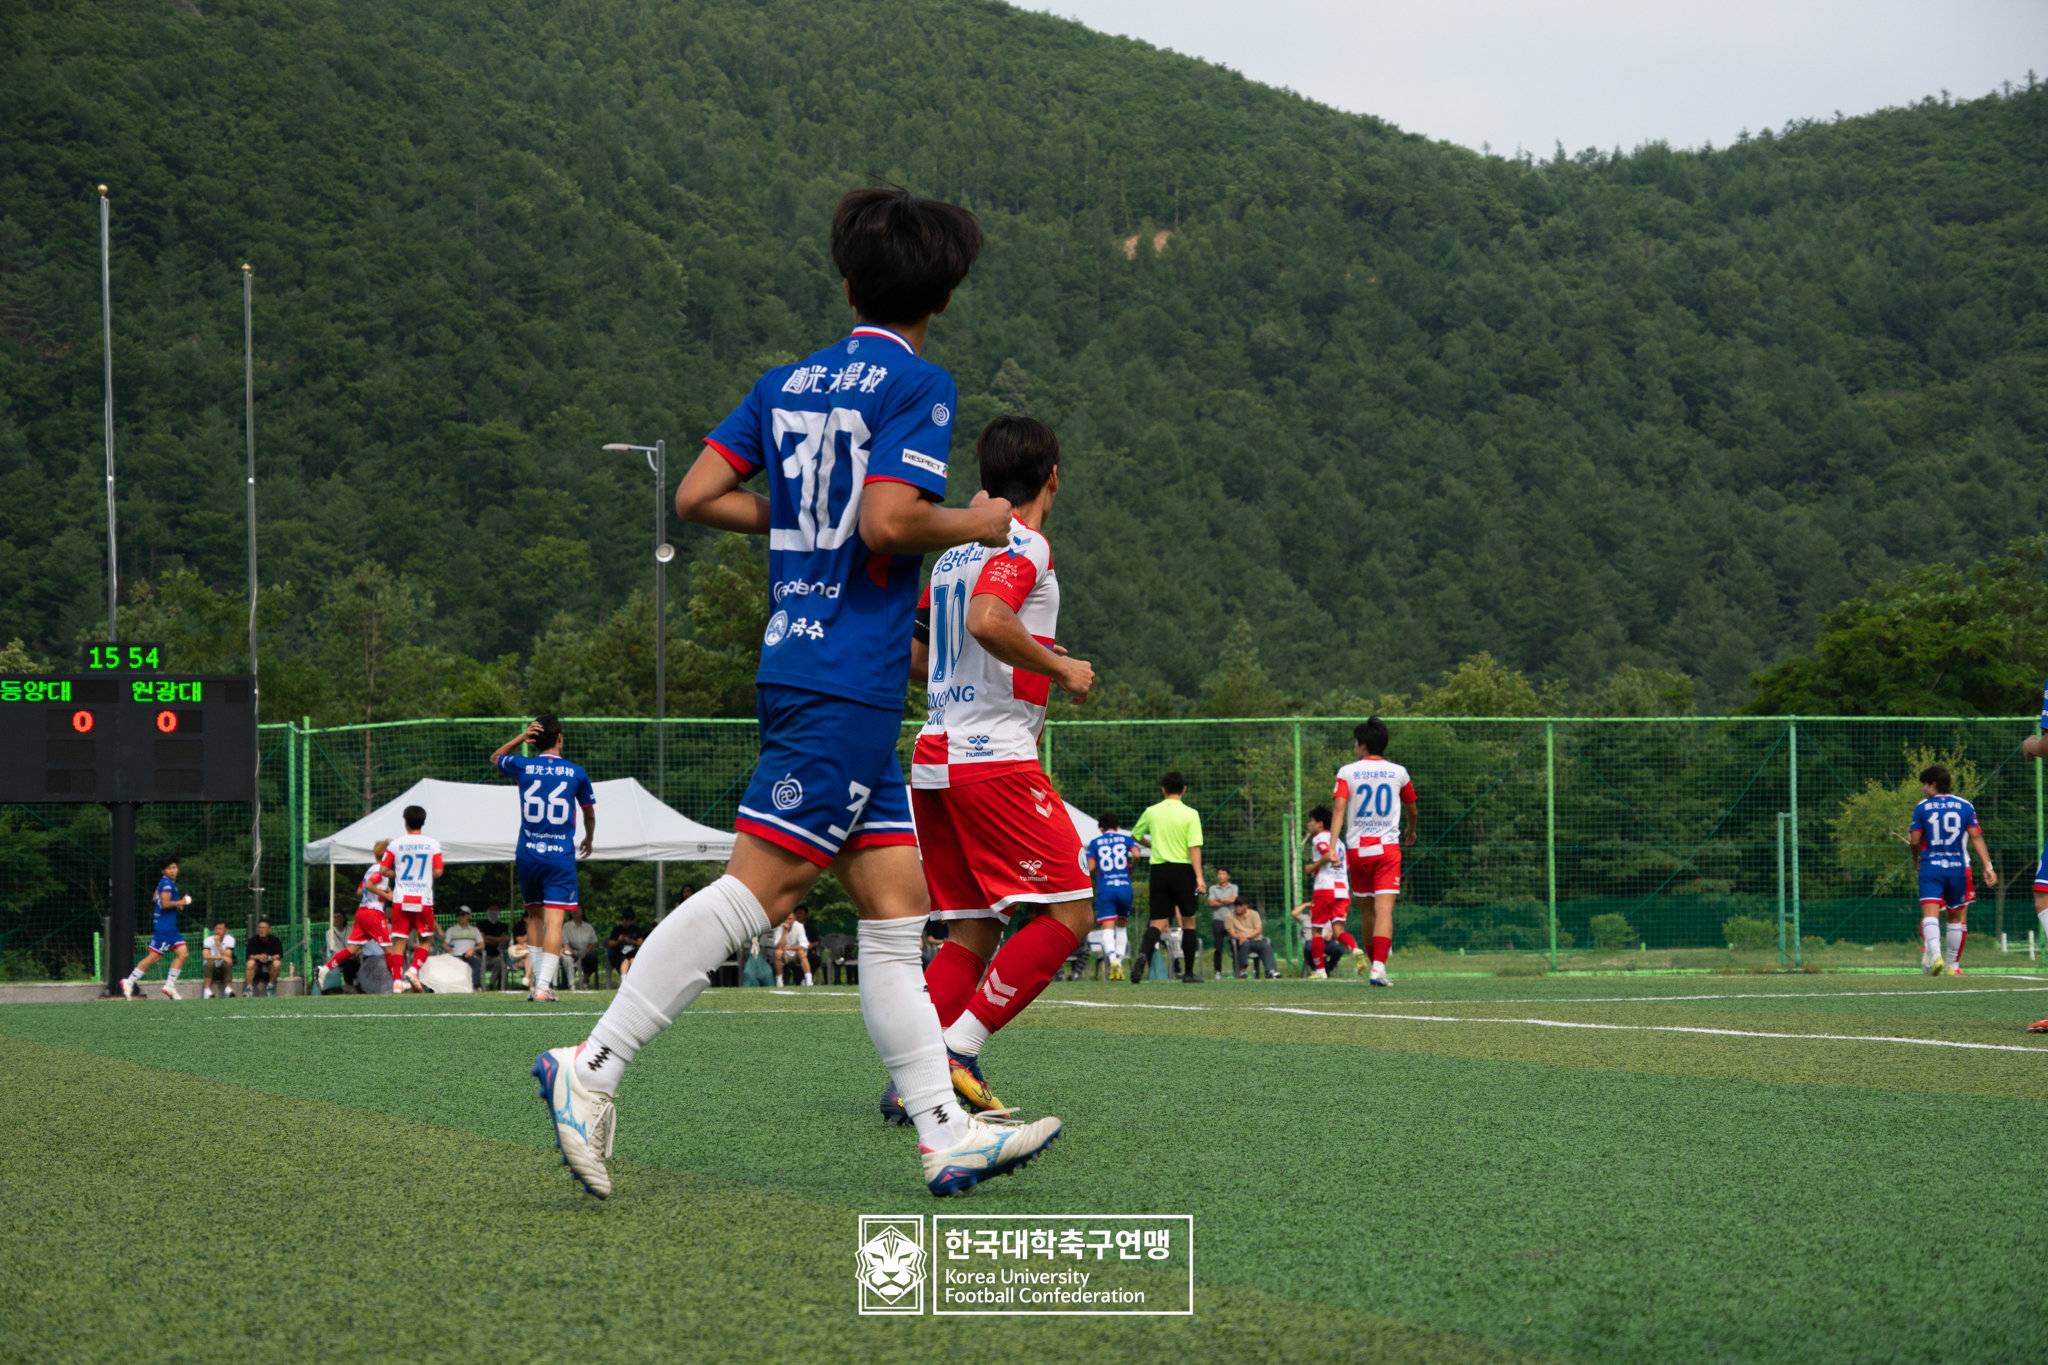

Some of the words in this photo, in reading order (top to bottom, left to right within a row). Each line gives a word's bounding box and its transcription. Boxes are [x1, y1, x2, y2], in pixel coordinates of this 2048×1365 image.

[904, 453, 941, 470] RESPECT
[933, 578, 966, 683] 10
[90, 646, 121, 669] 15
[128, 646, 160, 669] 54
[0, 680, 72, 702] 동양대
[132, 681, 203, 702] 원광대
[73, 710, 94, 733] 0
[156, 710, 178, 733] 0
[965, 749, 994, 758] hummel
[523, 780, 570, 825] 66
[1356, 783, 1393, 818] 20
[1353, 820, 1393, 828] DONGYANG
[1928, 812, 1962, 846] 19
[401, 854, 429, 881] 27
[1098, 843, 1128, 872] 88
